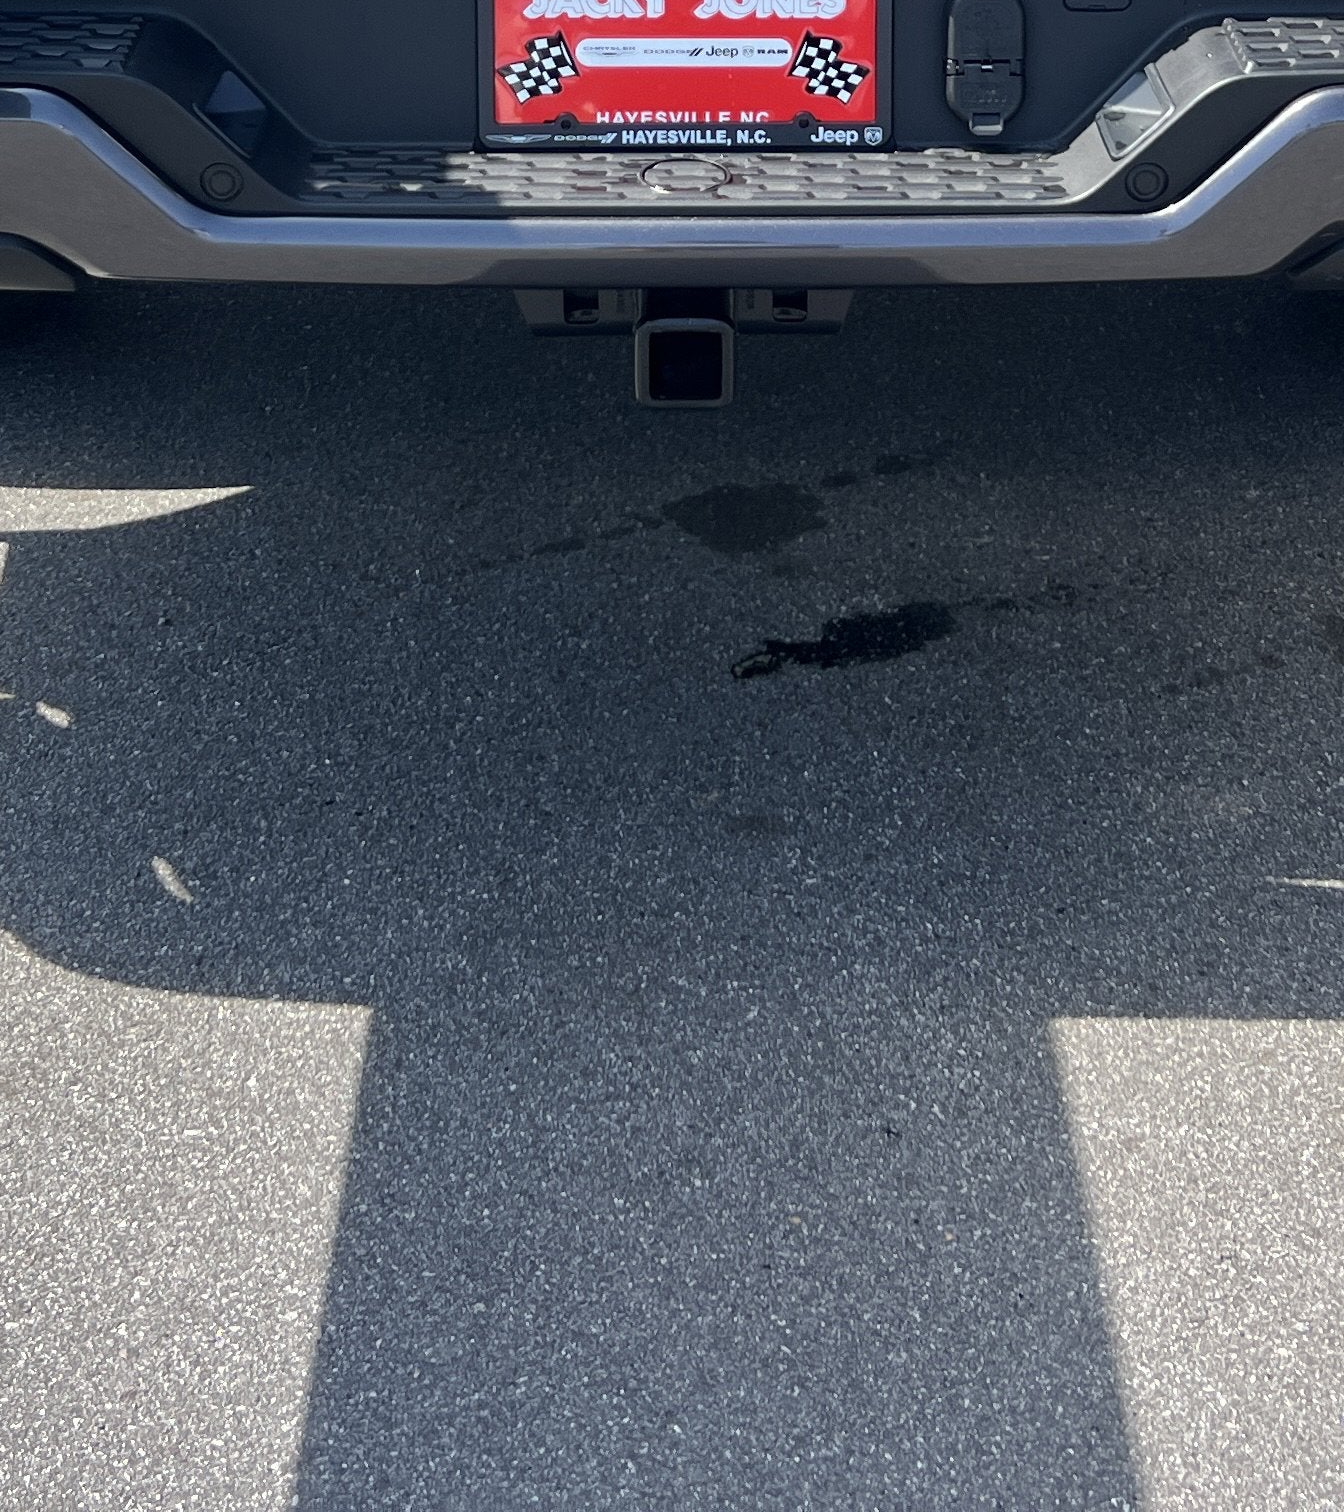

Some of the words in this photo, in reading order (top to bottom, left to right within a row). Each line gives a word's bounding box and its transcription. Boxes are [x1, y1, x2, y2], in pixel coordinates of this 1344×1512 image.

[705, 45, 739, 59] Jeep
[621, 129, 732, 146] HAYESVILLE,
[736, 129, 772, 145] N.C.
[810, 127, 859, 145] Jeep
